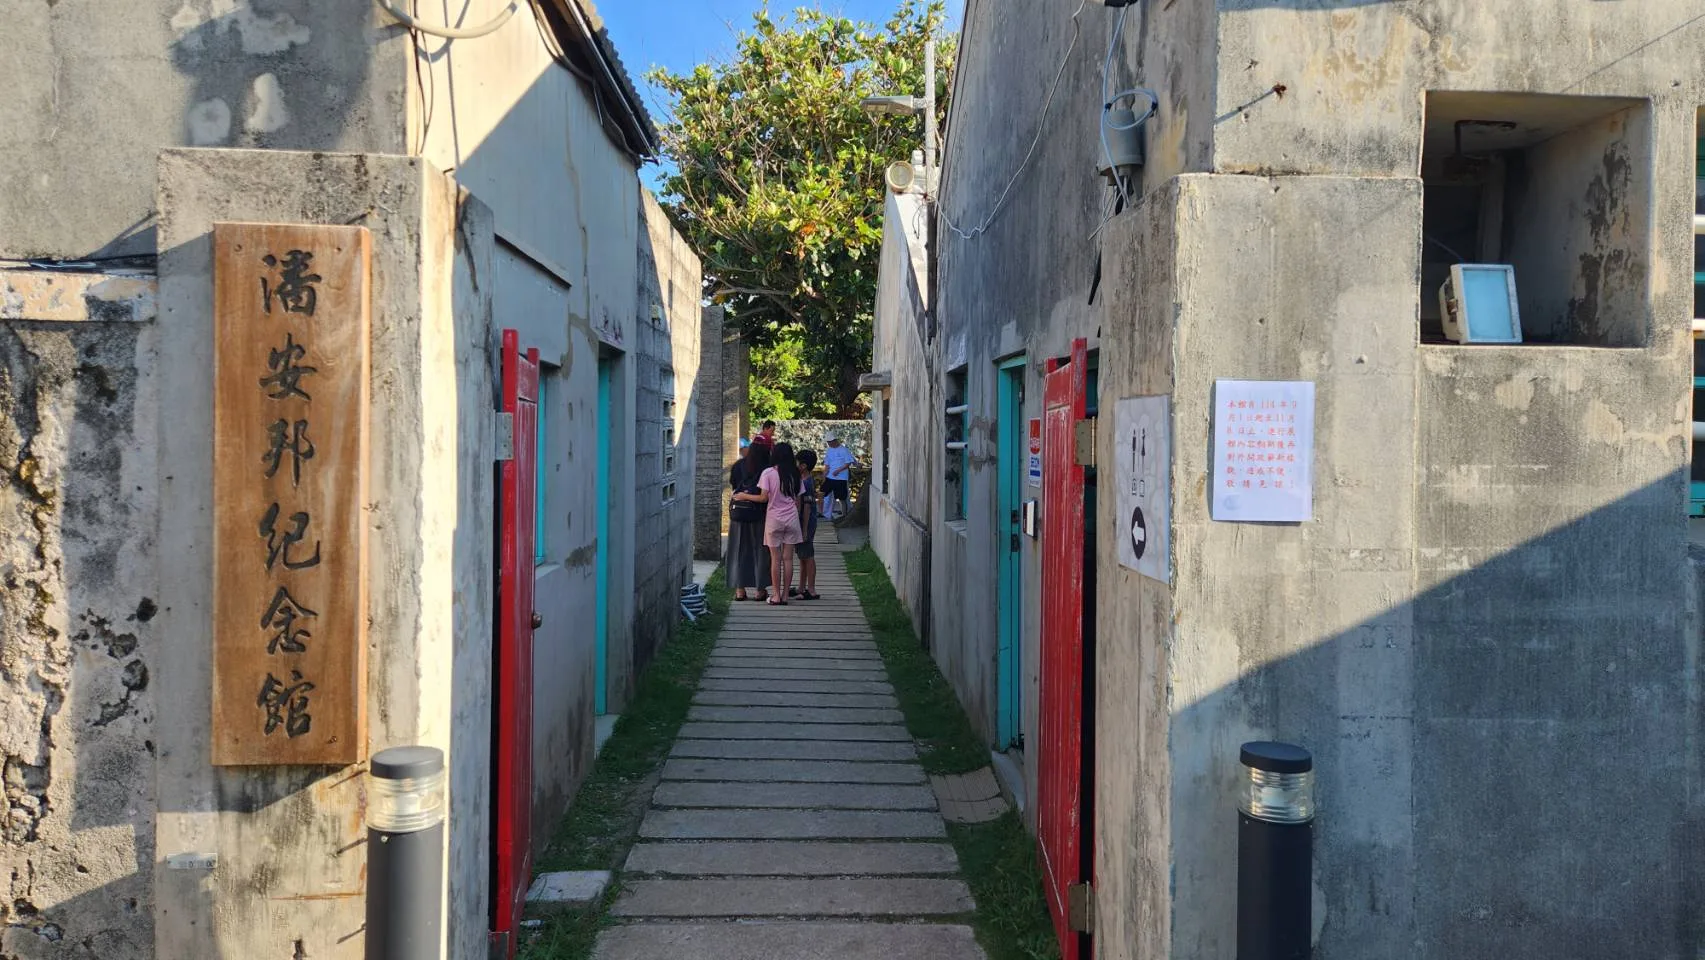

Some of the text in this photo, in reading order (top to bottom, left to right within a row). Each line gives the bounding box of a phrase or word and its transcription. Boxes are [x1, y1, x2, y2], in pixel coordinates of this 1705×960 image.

[256, 249, 322, 739] 潘安邦紀念館
